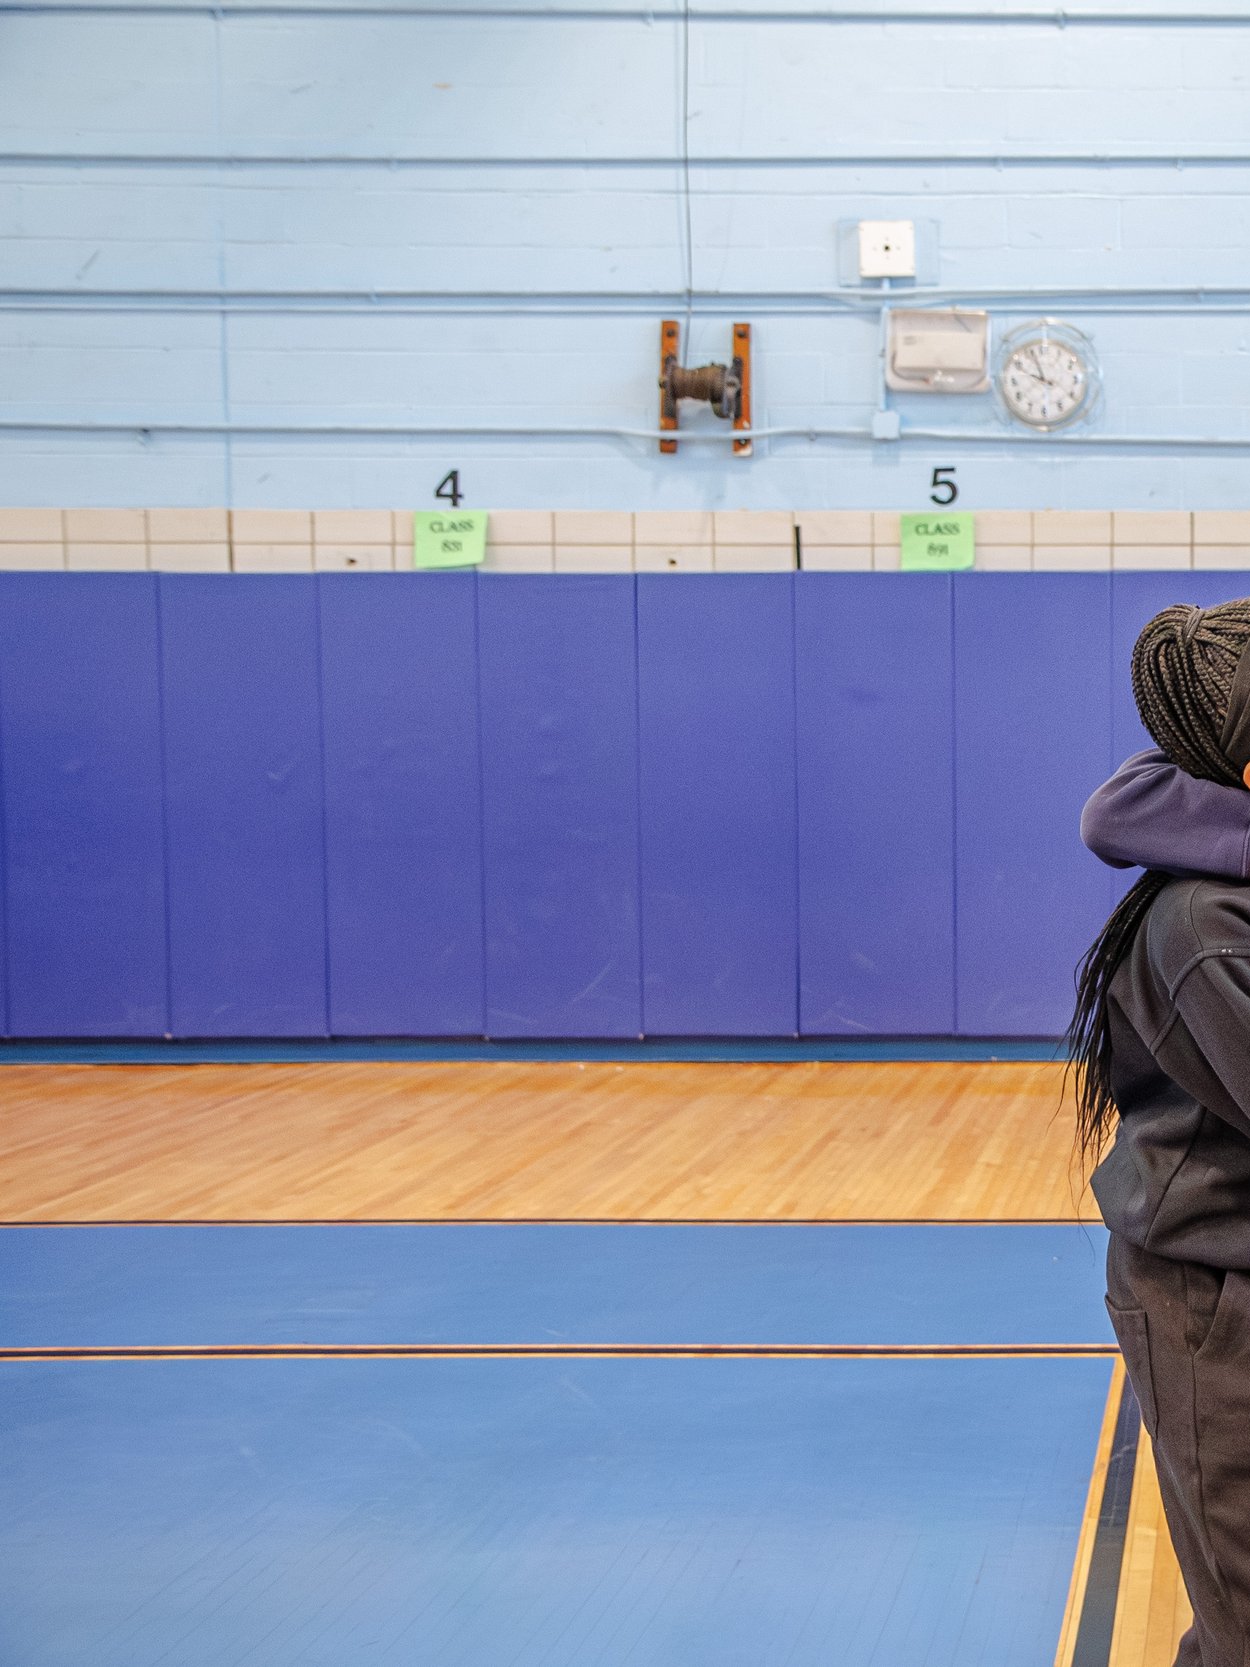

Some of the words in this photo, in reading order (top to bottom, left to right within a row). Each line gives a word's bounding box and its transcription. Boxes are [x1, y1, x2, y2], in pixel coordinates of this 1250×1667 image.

[436, 469, 463, 507] 4
[931, 467, 957, 505] 5
[429, 519, 474, 533] CLASS
[914, 522, 960, 536] CLASS
